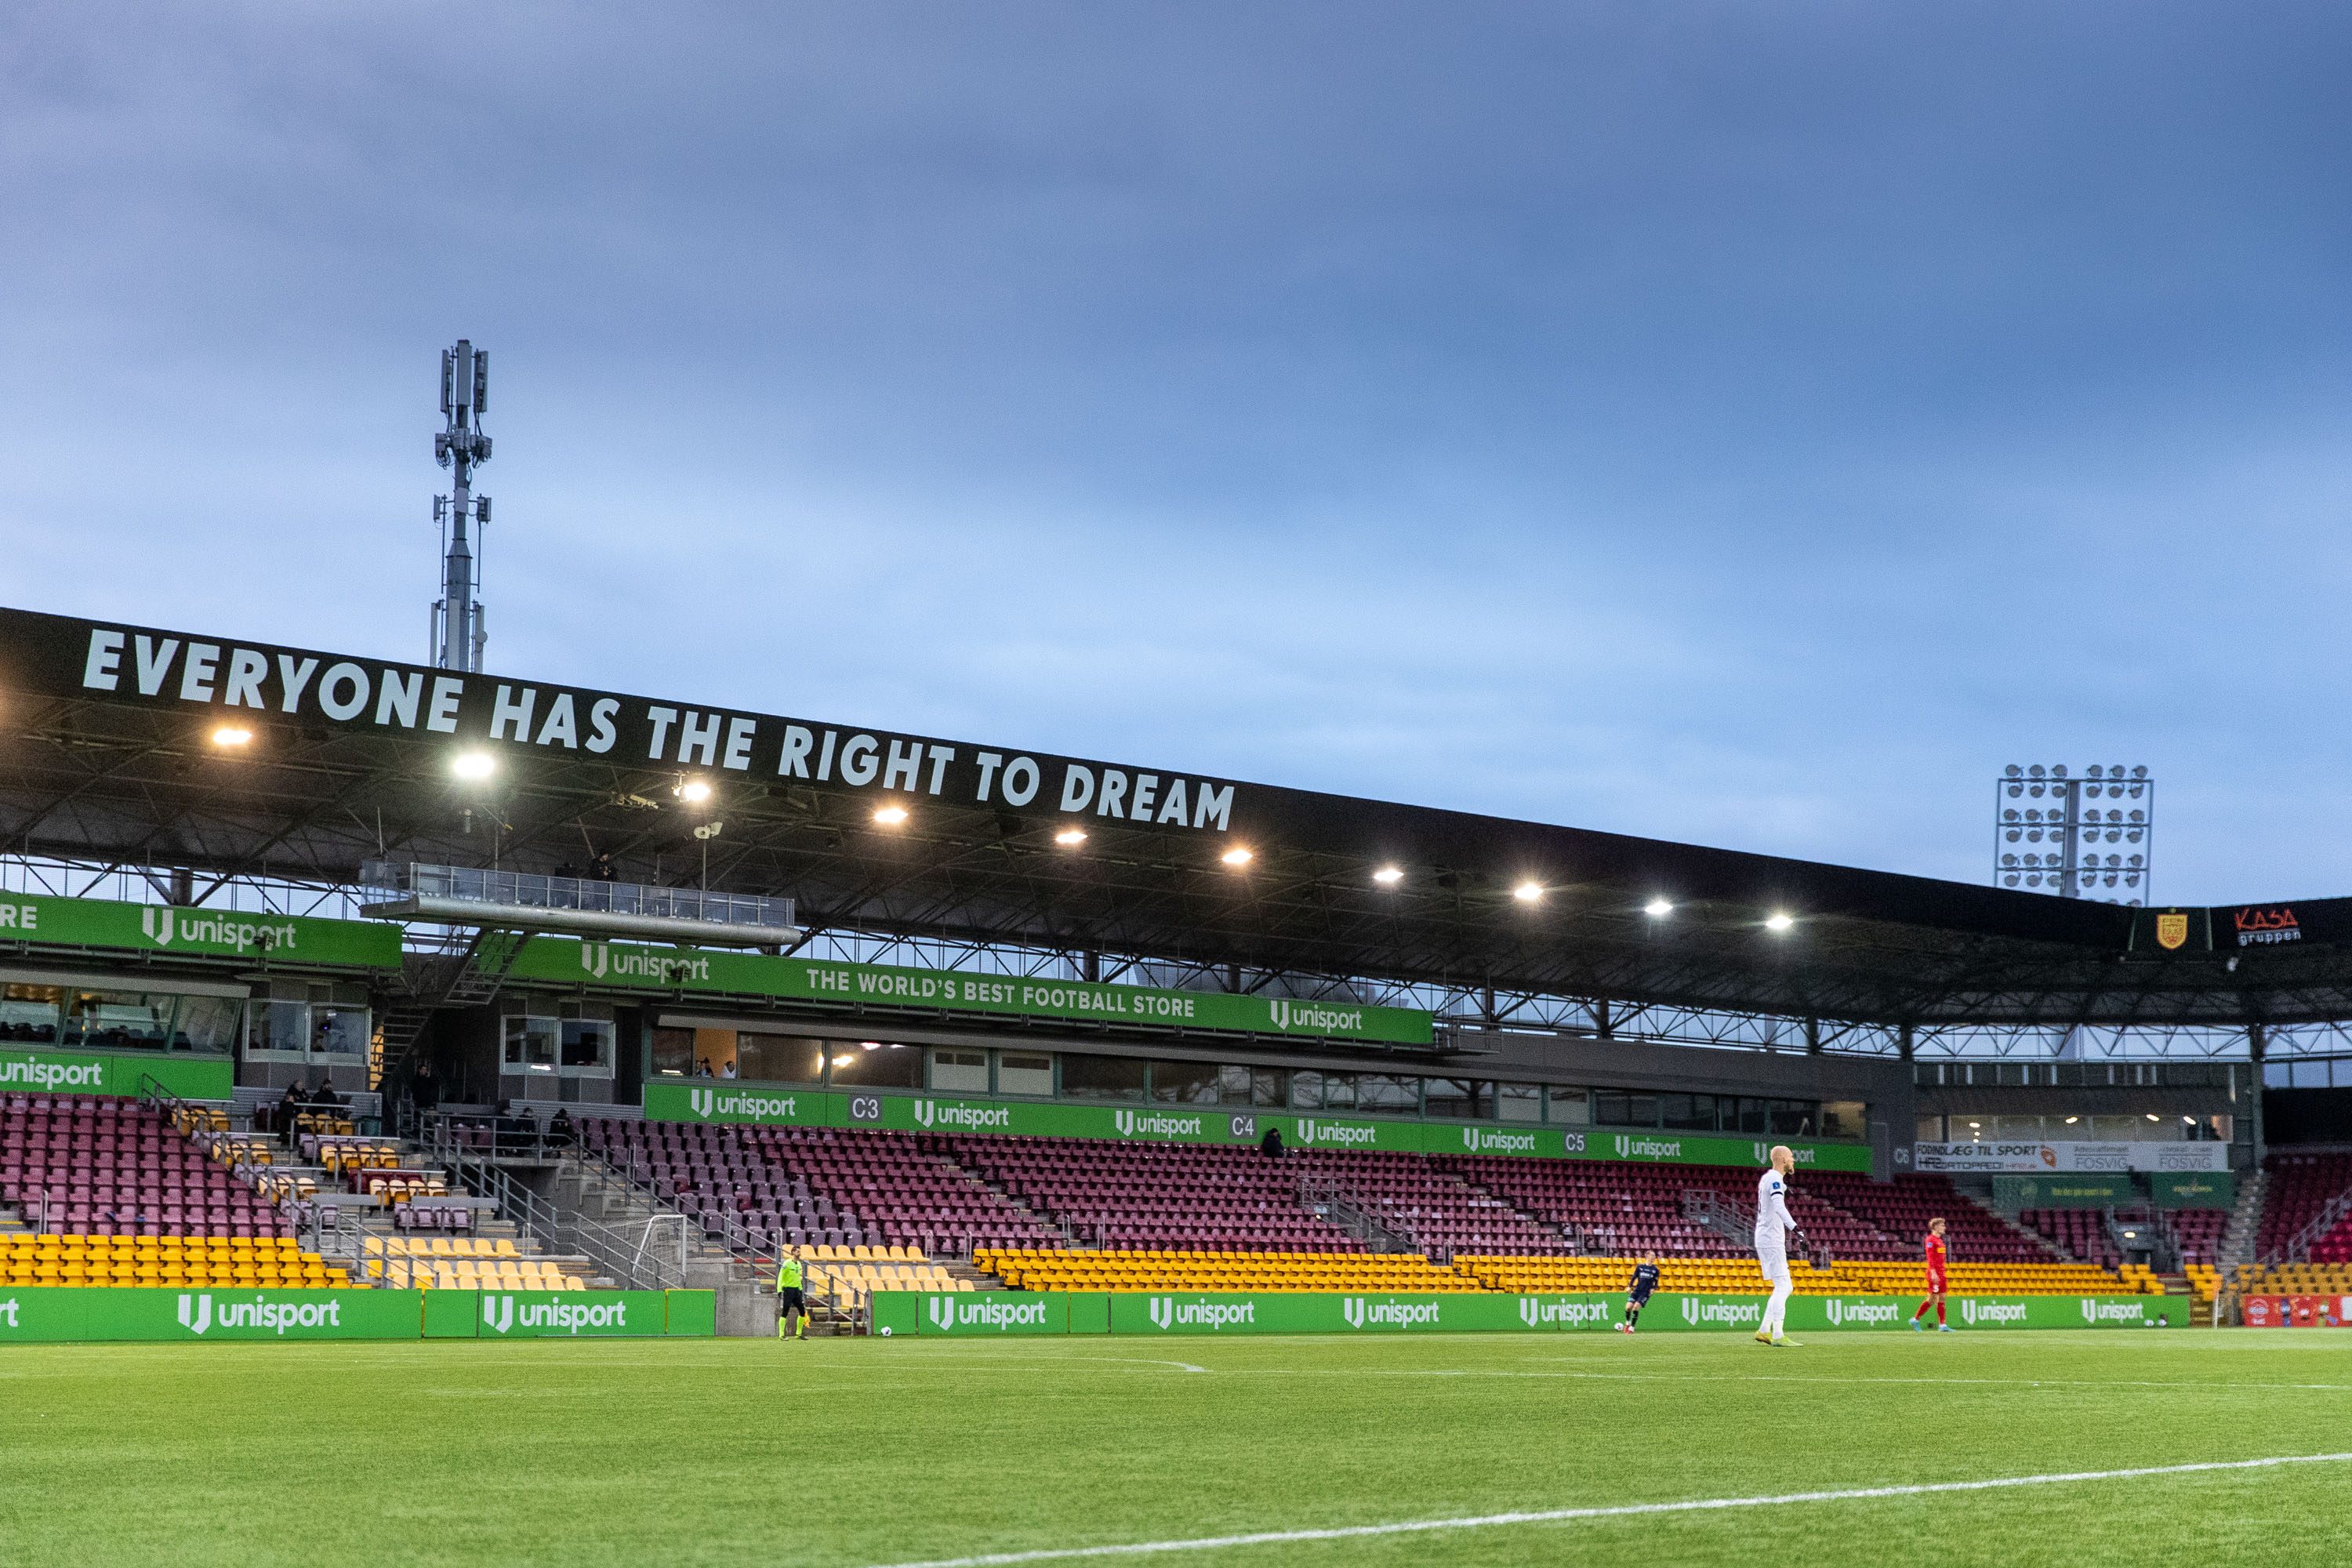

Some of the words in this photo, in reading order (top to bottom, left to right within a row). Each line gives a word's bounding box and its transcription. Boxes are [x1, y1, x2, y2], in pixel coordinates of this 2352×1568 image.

[83, 629, 464, 734] EVERYONE
[489, 684, 621, 754] HAS
[648, 706, 757, 771] THE
[779, 724, 955, 794] RIGHT
[977, 753, 1040, 806] TO
[1060, 765, 1236, 832] DREAM
[2238, 931, 2301, 946] gruppen
[807, 969, 849, 991] THE
[858, 971, 957, 999] WORLD'S
[964, 981, 1014, 1003] BEST
[1023, 985, 1127, 1012] FOOTBALL
[1134, 995, 1194, 1018] STORE
[1294, 1004, 1362, 1033] unisport
[717, 1091, 796, 1122] unisport
[852, 1098, 879, 1120] C3
[938, 1102, 1009, 1131] unisport
[1136, 1112, 1201, 1139] unisport
[1232, 1116, 1254, 1136] C4
[1317, 1122, 1375, 1147] unisport
[1482, 1131, 1535, 1154] unisport
[1565, 1133, 1585, 1152] C5
[1631, 1137, 1681, 1160] unisport
[1894, 1147, 1910, 1164] C6
[1977, 1145, 1994, 1156] TIL
[1997, 1145, 2038, 1156] SPORT
[2076, 1156, 2129, 1170] FOSVIG
[2158, 1156, 2212, 1170] FOSVIG
[219, 1295, 339, 1334] unisport
[520, 1297, 626, 1334] unisport
[959, 1298, 1046, 1330] unisport
[1177, 1298, 1254, 1330] unisport
[1368, 1298, 1439, 1328] unisport
[1541, 1298, 1608, 1327] unisport
[1701, 1298, 1760, 1327] unisport
[1841, 1299, 1899, 1325] unisport
[1977, 1300, 2027, 1324] unisport
[2094, 1300, 2143, 1323] unisport
